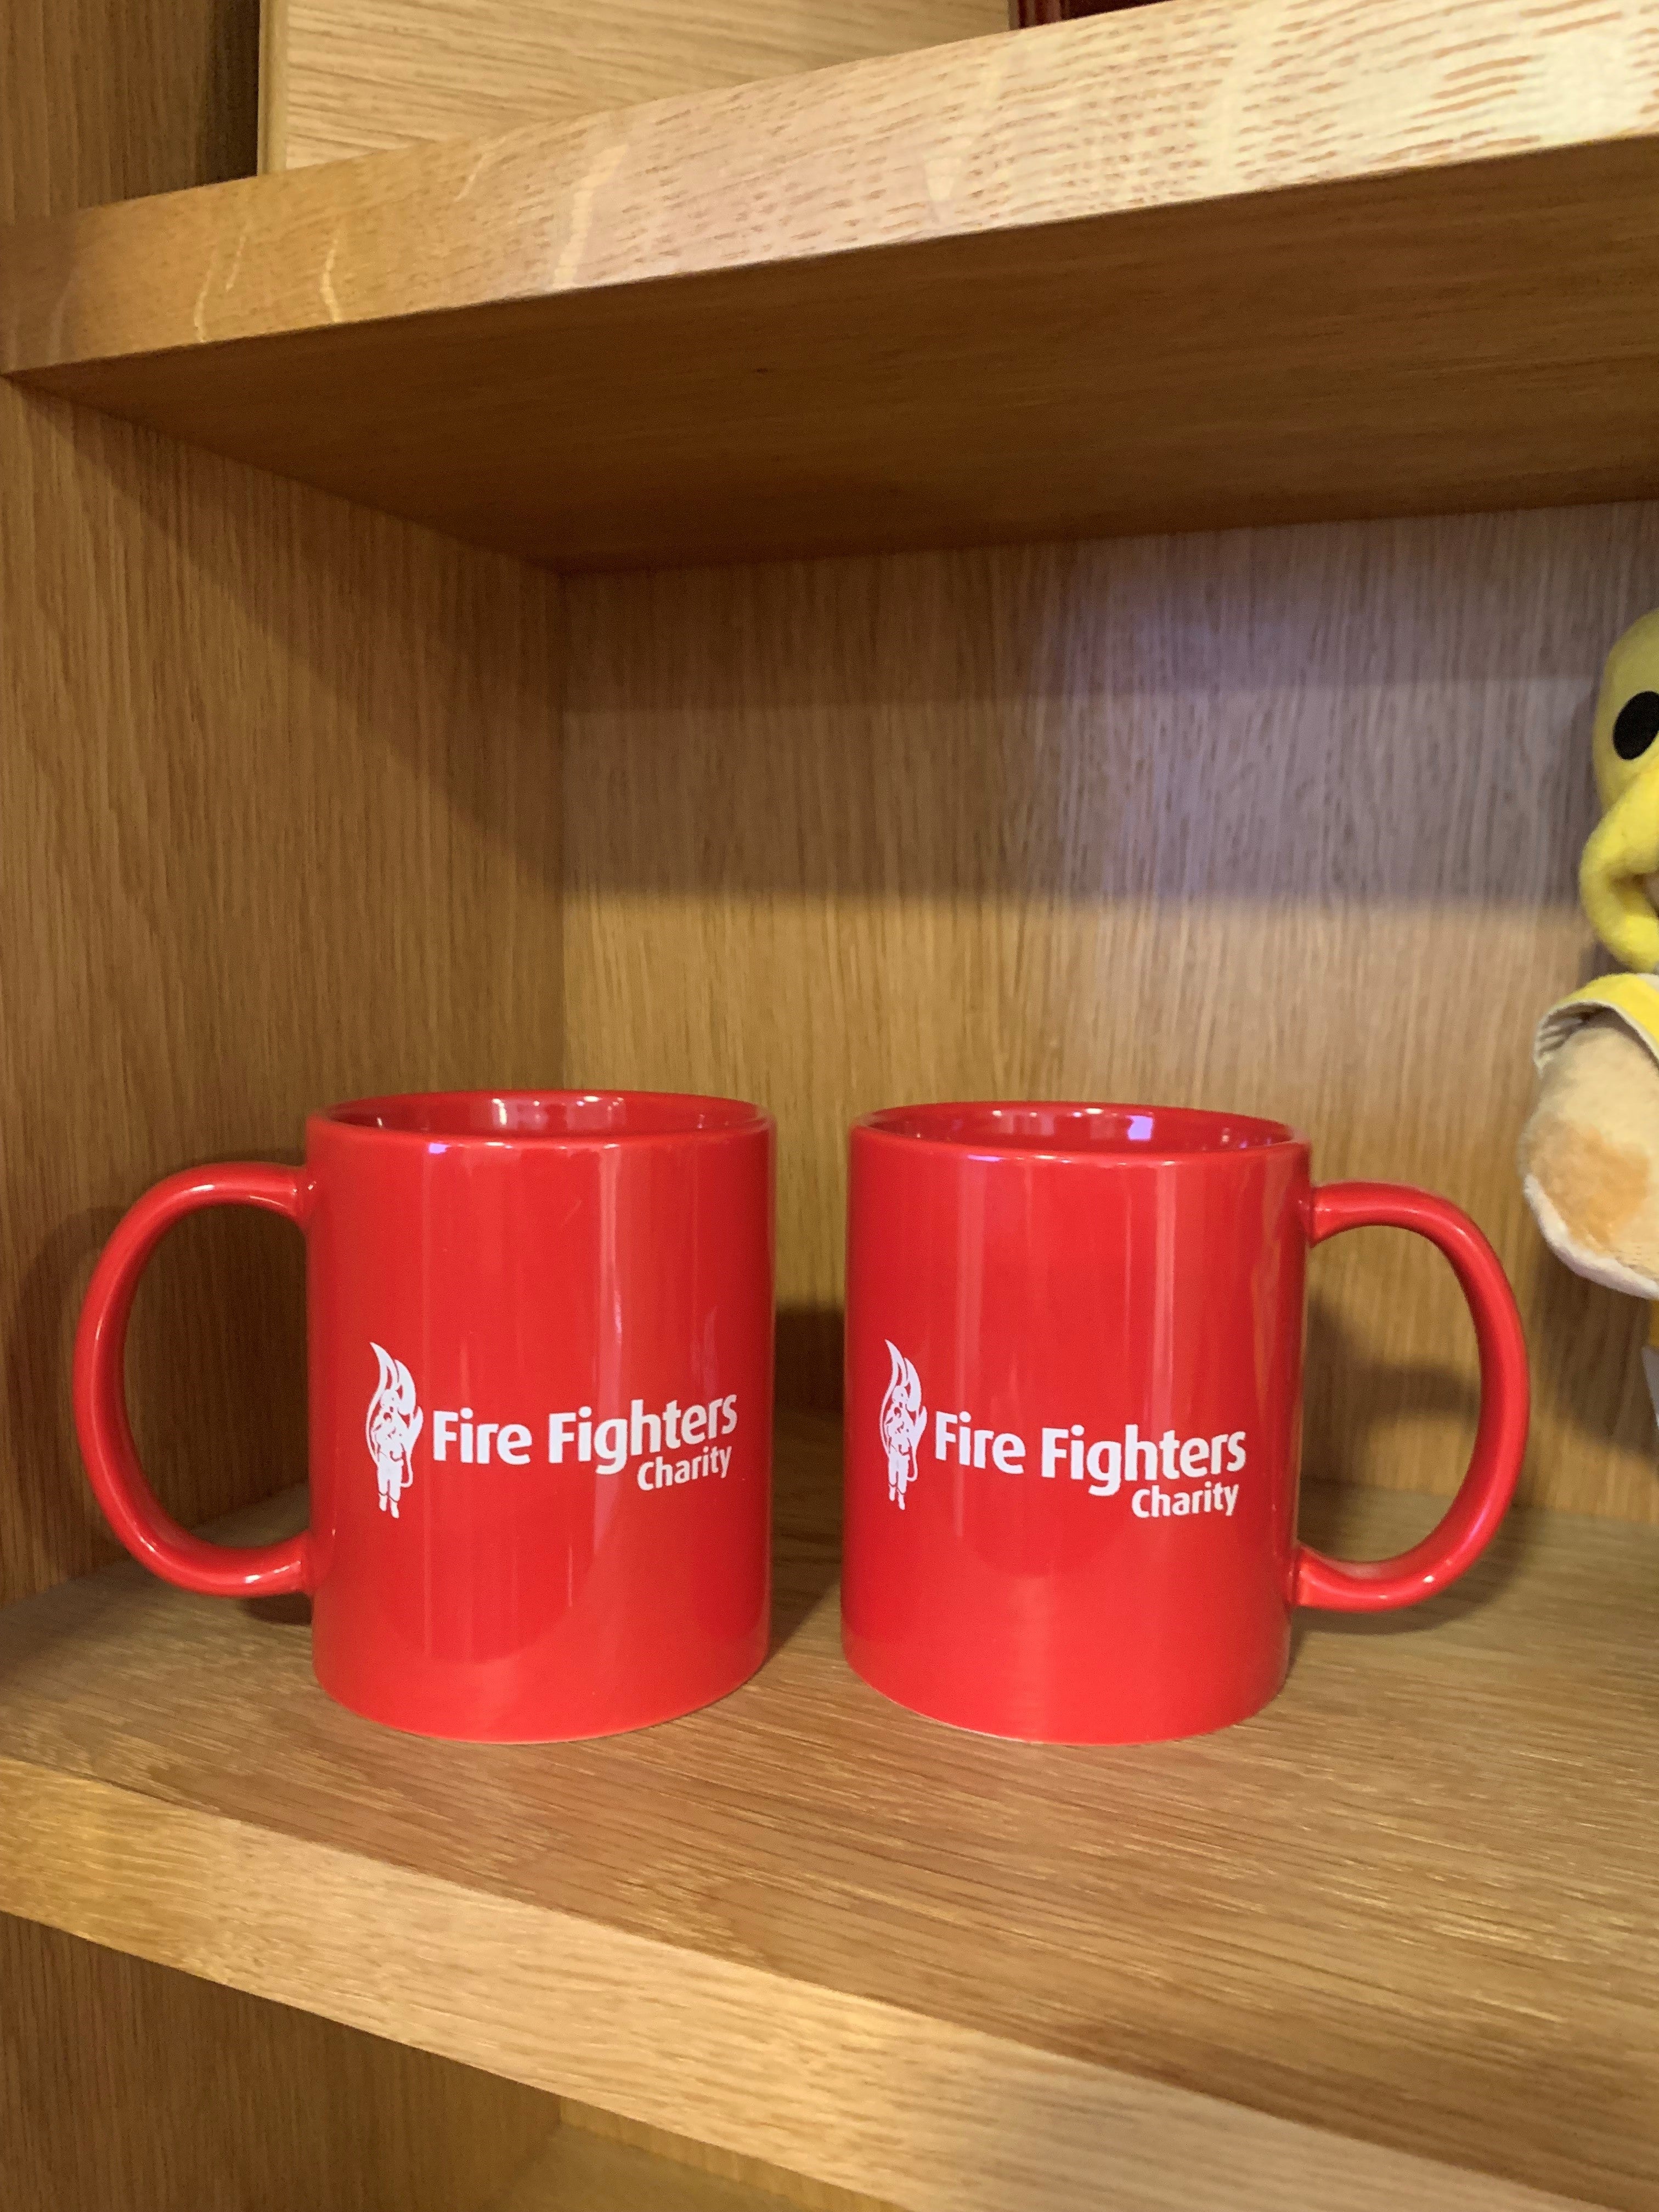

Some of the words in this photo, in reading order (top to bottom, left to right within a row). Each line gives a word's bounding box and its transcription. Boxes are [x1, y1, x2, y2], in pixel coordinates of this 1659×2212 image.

[432, 1407, 532, 1465] Fire
[548, 1394, 737, 1475] Fighters
[935, 1410, 1026, 1475] Fire
[1041, 1424, 1246, 1497] Fighters
[637, 1446, 732, 1491] Charity
[1131, 1481, 1239, 1519] Charity
